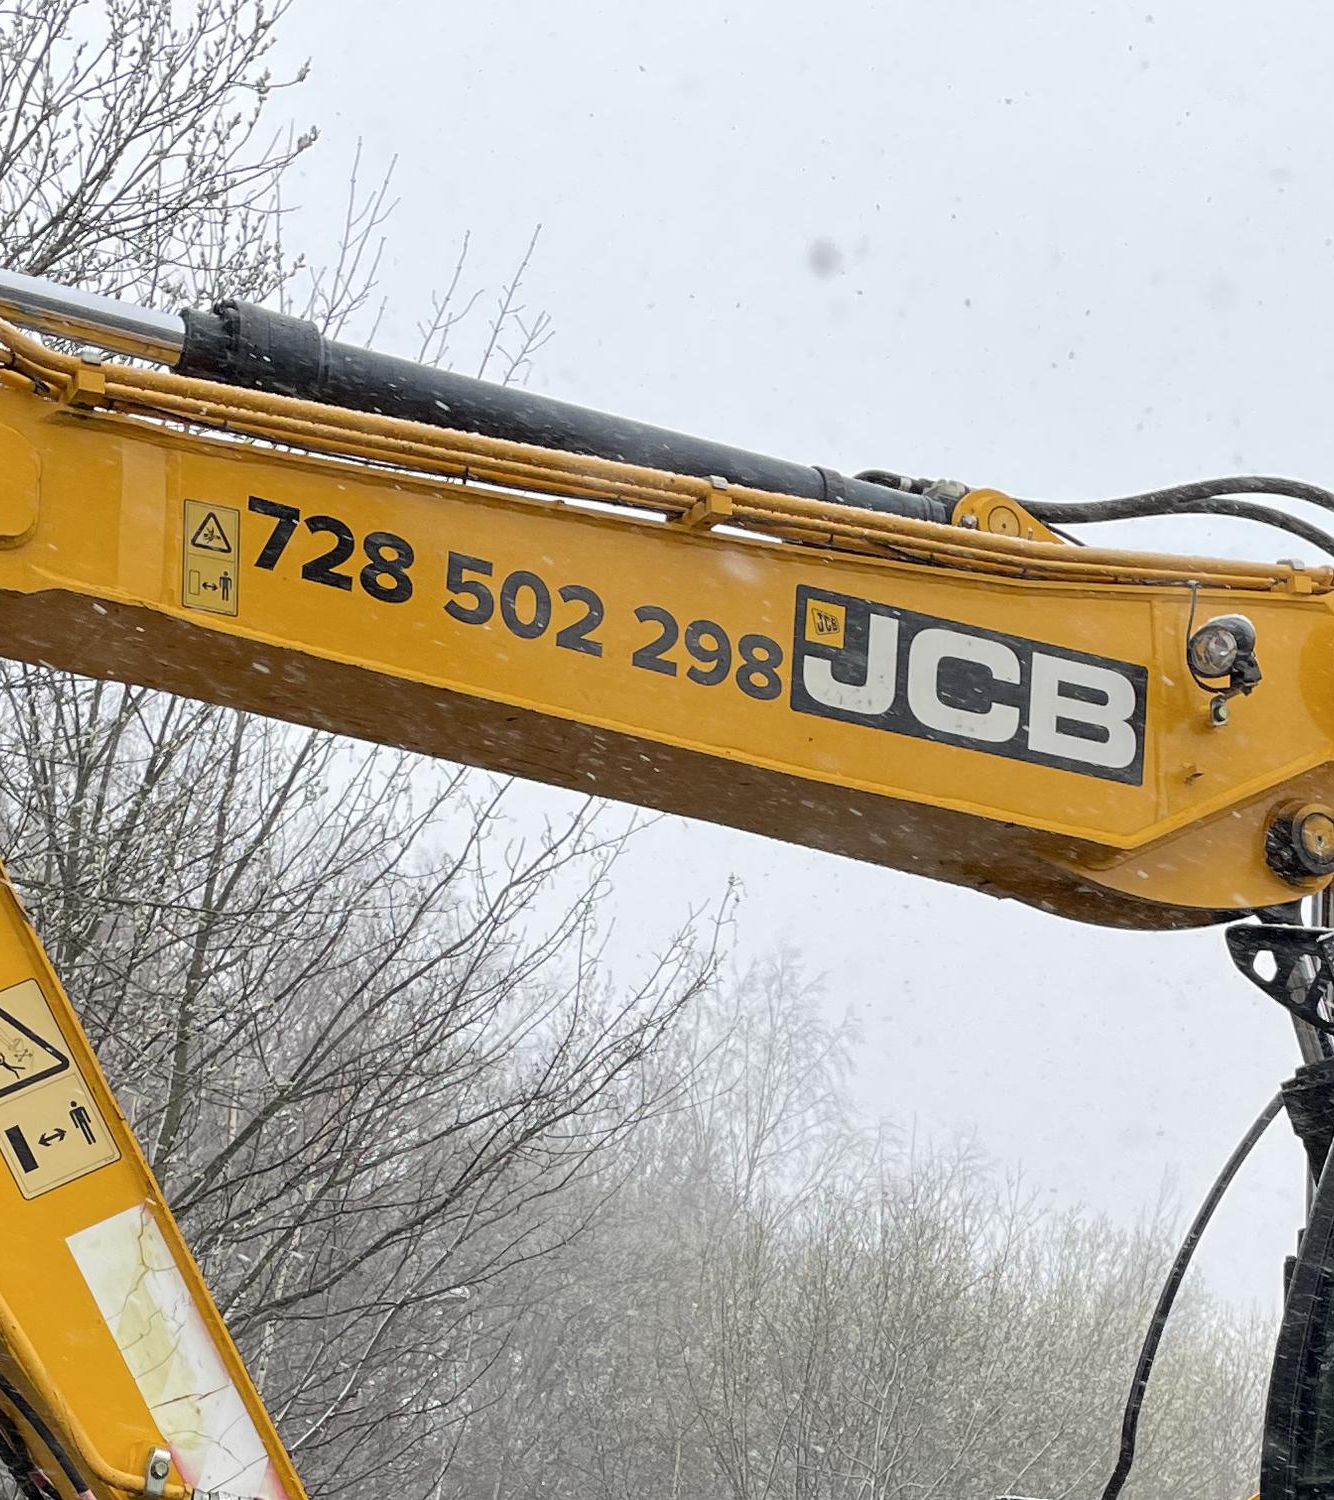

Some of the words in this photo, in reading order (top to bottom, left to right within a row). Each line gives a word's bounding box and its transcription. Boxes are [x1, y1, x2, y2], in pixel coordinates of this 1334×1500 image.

[247, 495, 415, 604] 728
[442, 550, 605, 658] 502
[631, 604, 784, 701] 298
[815, 608, 841, 634] JCB
[802, 612, 1138, 769] JCB
